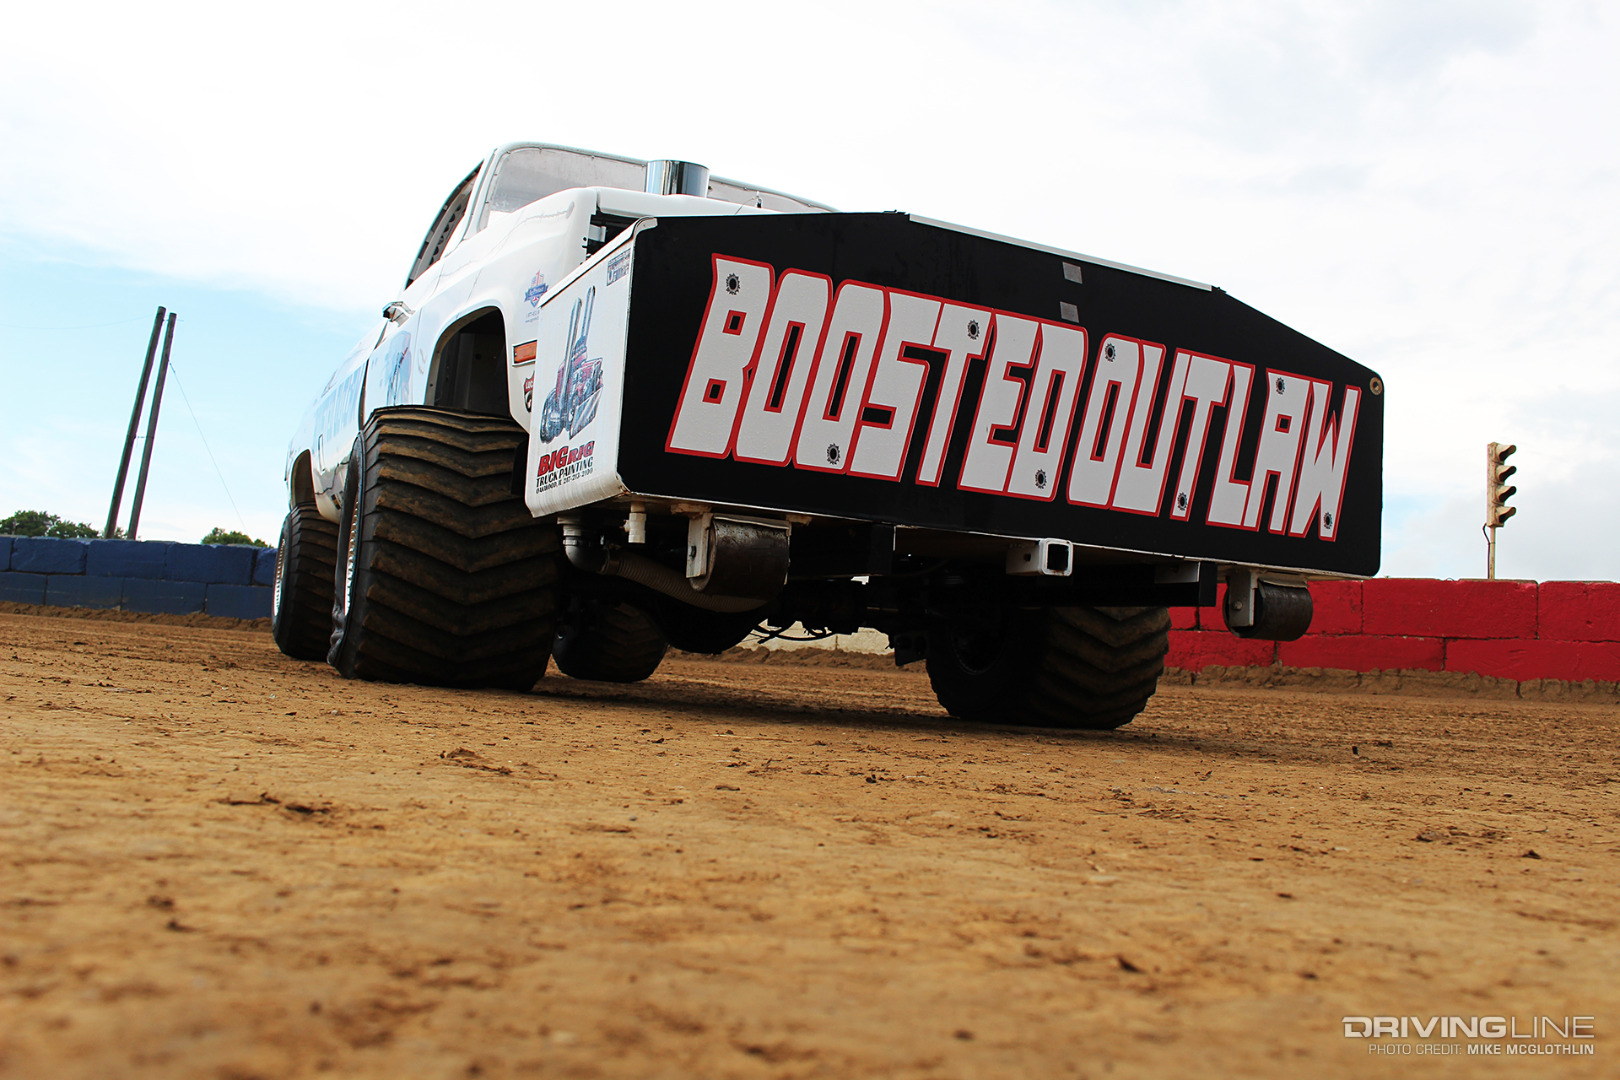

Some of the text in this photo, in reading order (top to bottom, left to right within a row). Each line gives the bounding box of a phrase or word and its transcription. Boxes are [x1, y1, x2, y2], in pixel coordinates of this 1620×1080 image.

[536, 456, 594, 488] TRUCK PAINTING
[537, 440, 595, 477] BIG RIG
